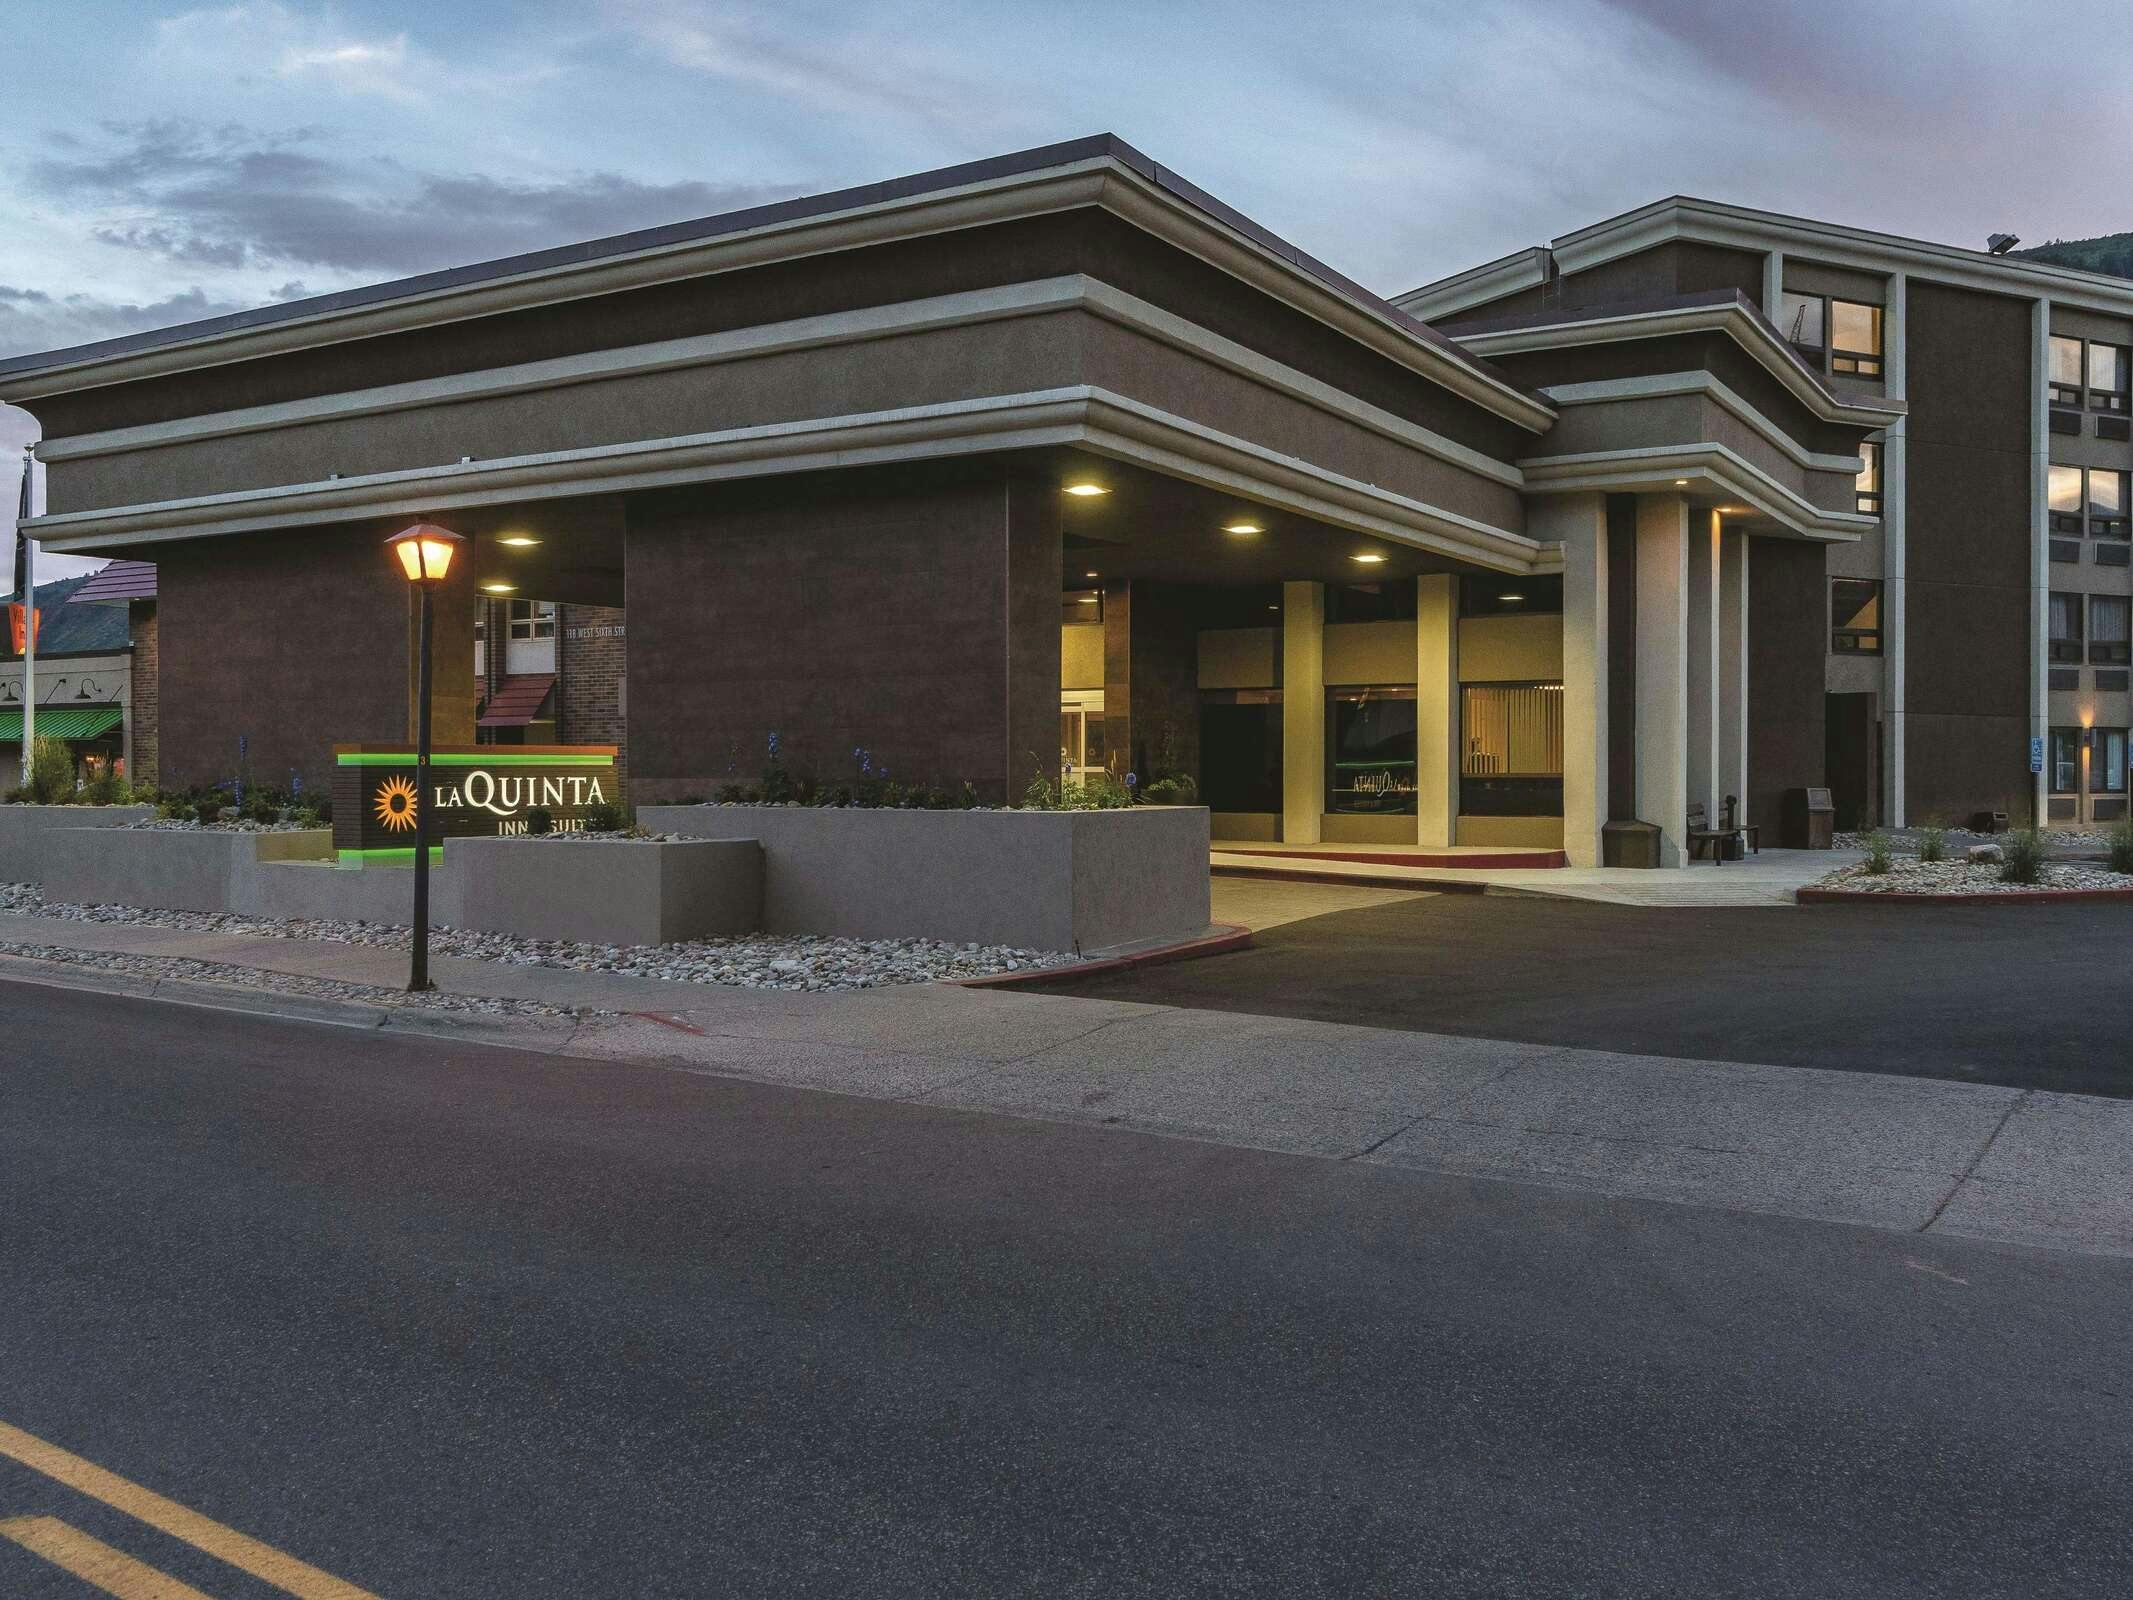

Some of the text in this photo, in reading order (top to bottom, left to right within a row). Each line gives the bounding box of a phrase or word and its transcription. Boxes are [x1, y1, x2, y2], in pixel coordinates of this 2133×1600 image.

[578, 627, 593, 638] WEST
[595, 626, 613, 637] SIXTH
[419, 755, 426, 766] 3
[434, 770, 606, 816] LA QUINTA
[498, 820, 529, 836] INN
